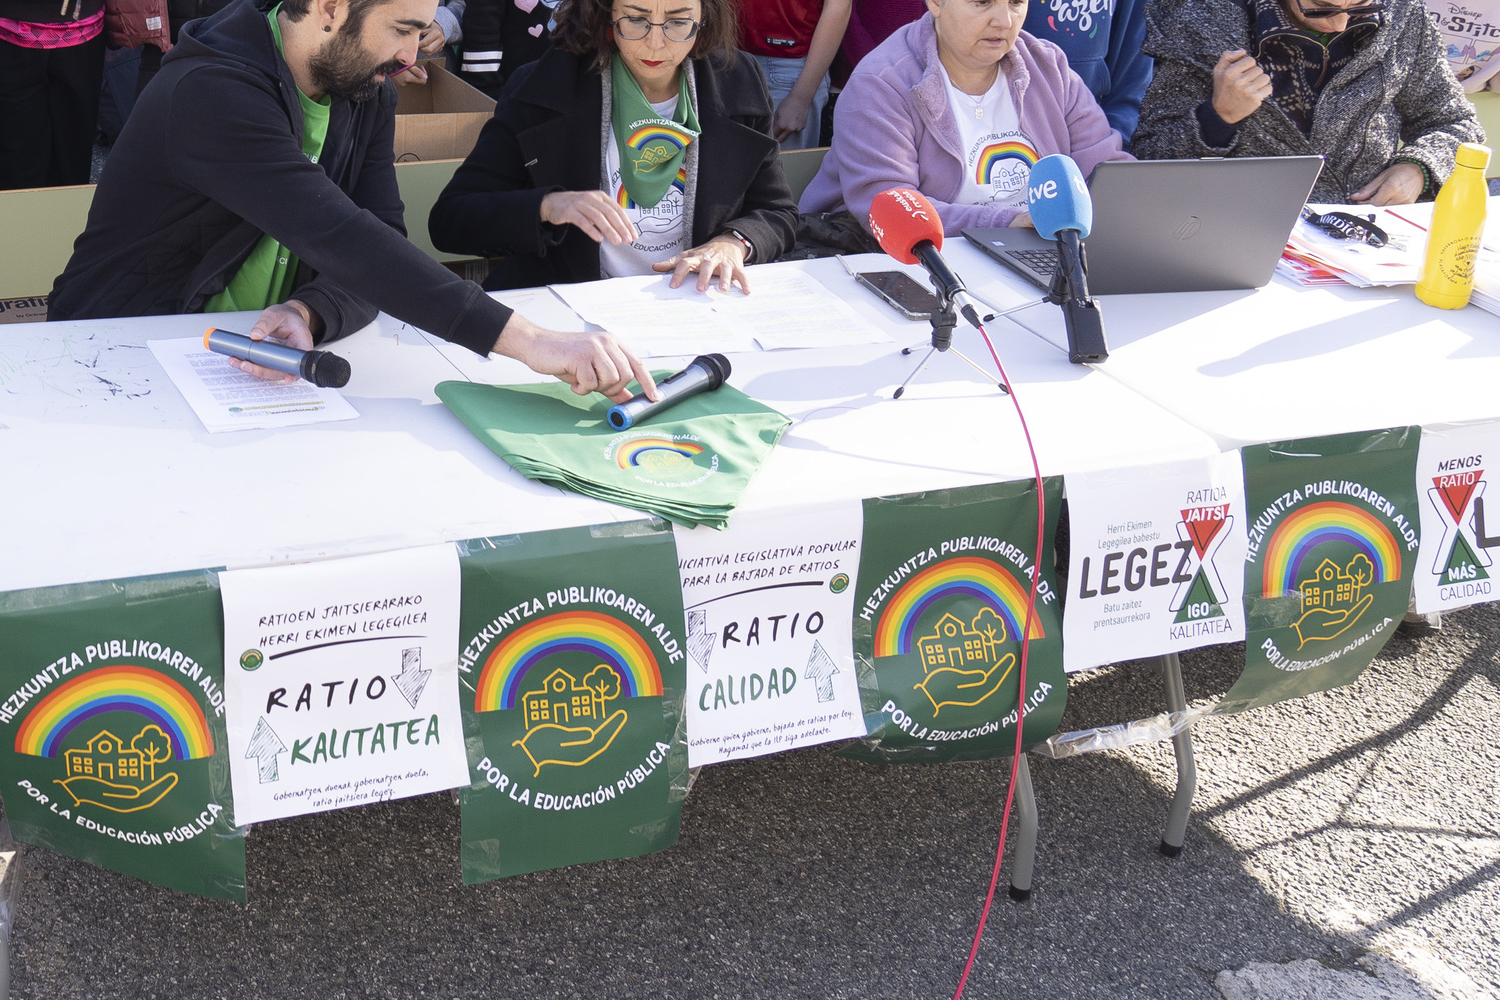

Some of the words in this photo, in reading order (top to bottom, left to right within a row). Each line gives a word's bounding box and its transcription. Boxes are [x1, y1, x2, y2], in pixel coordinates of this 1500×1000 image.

[1448, 16, 1500, 38] Stitc
[1028, 179, 1058, 205] tve
[1437, 455, 1482, 472] MENOS
[1186, 486, 1227, 504] RATIOA
[1439, 473, 1475, 489] RATIO
[1107, 523, 1126, 534] Herri
[1127, 520, 1153, 532] Ekimen
[1185, 505, 1225, 523] JAITSI
[1246, 489, 1303, 563] HEZKUNTZA
[1304, 480, 1395, 517] PUBLIKOAREN
[1392, 514, 1419, 552] ALDE
[734, 545, 804, 564] LEGISLATIVA
[808, 540, 857, 556] POPULAR
[1098, 534, 1132, 550] Legegilea
[1133, 532, 1160, 543] babestu
[683, 574, 711, 589] PARA
[715, 572, 728, 584] LA
[732, 567, 775, 582] BAJADA
[779, 565, 795, 575] DE
[799, 559, 840, 573] RATIOS
[859, 548, 938, 621] HEZKUNTZA
[940, 536, 1029, 569] PUBLIKOAREN
[1024, 564, 1056, 605] ADE
[1079, 540, 1195, 599] LEGEZ
[1448, 561, 1477, 581] MÁS
[1440, 582, 1492, 601] CALIDAD
[258, 608, 316, 627] RATIOEN
[321, 595, 423, 620] JAITSIERARAKO
[1103, 602, 1121, 613] Batu
[1121, 600, 1142, 611] zaitez
[1187, 602, 1209, 618] IGO
[259, 632, 299, 647] HERRI
[305, 622, 357, 640] EKIMEN
[362, 612, 427, 633] LEGEGILEA
[457, 597, 544, 673] HEZKUNTZA
[546, 586, 656, 627] PUBLIKOAREN
[651, 622, 684, 664] ALDE
[722, 611, 824, 649] RATIO
[1093, 612, 1151, 631] prentsaurrekora
[1169, 618, 1233, 641] KALITATEA
[1261, 637, 1277, 665] POR
[1273, 654, 1288, 671] LA
[1285, 651, 1341, 673] EDUCACIÓN
[1342, 616, 1393, 655] PÚBLICA
[85, 639, 204, 681] PUBLIKOAREN
[199, 675, 226, 718] ALDE
[699, 667, 797, 712] CALIDAD
[266, 675, 386, 714] RATIO
[722, 732, 741, 744] quien
[773, 721, 795, 734] bajada
[797, 718, 806, 727] de
[807, 715, 827, 726] ratios
[828, 714, 840, 724] por
[881, 699, 913, 731] POR
[909, 722, 928, 740] LA
[926, 721, 999, 742] EDUCACIÓN
[291, 714, 440, 765] KALITATEA
[718, 743, 749, 758] Hagamos
[750, 740, 762, 751] que
[764, 737, 772, 746] la
[784, 732, 798, 744] siga
[273, 783, 322, 801] Gobernatzen
[324, 781, 352, 793] duenak
[353, 773, 402, 791] gobernatzen
[476, 757, 510, 792] POR
[509, 782, 530, 806] LA
[533, 785, 616, 811] EDUCACIÓN
[615, 741, 671, 795] PÚBLICA
[17, 779, 49, 805] POR
[50, 803, 70, 819] LA
[76, 815, 163, 846] EDUCACIÓN
[163, 802, 223, 844] PÚBLICA
[312, 797, 333, 807] ratio
[334, 792, 368, 808] jaitsiera
